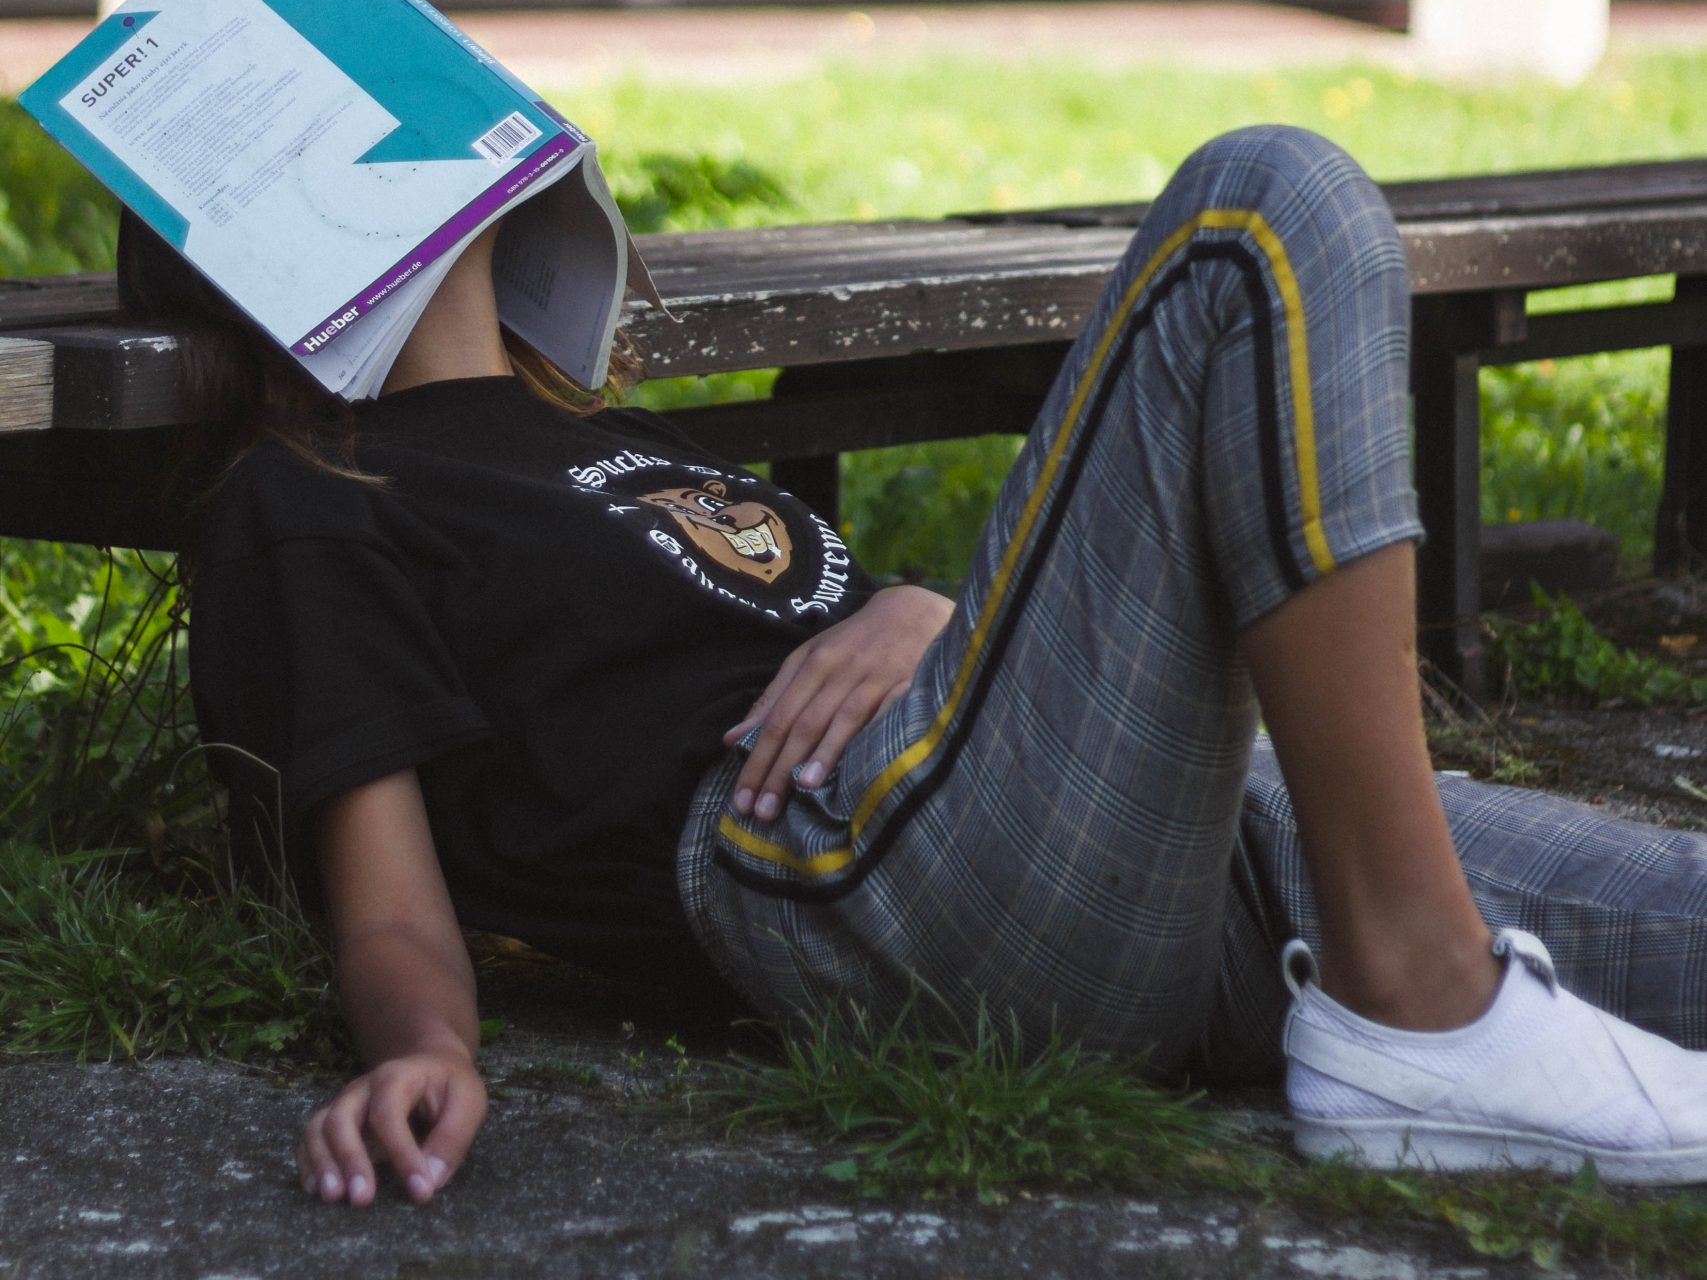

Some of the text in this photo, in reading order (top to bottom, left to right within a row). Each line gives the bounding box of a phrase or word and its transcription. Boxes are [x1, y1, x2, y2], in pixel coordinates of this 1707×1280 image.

[81, 36, 160, 108] SUPER! 1
[366, 261, 422, 305] www.hueber.de
[303, 306, 361, 352] Hueber
[568, 450, 672, 488] Sucks
